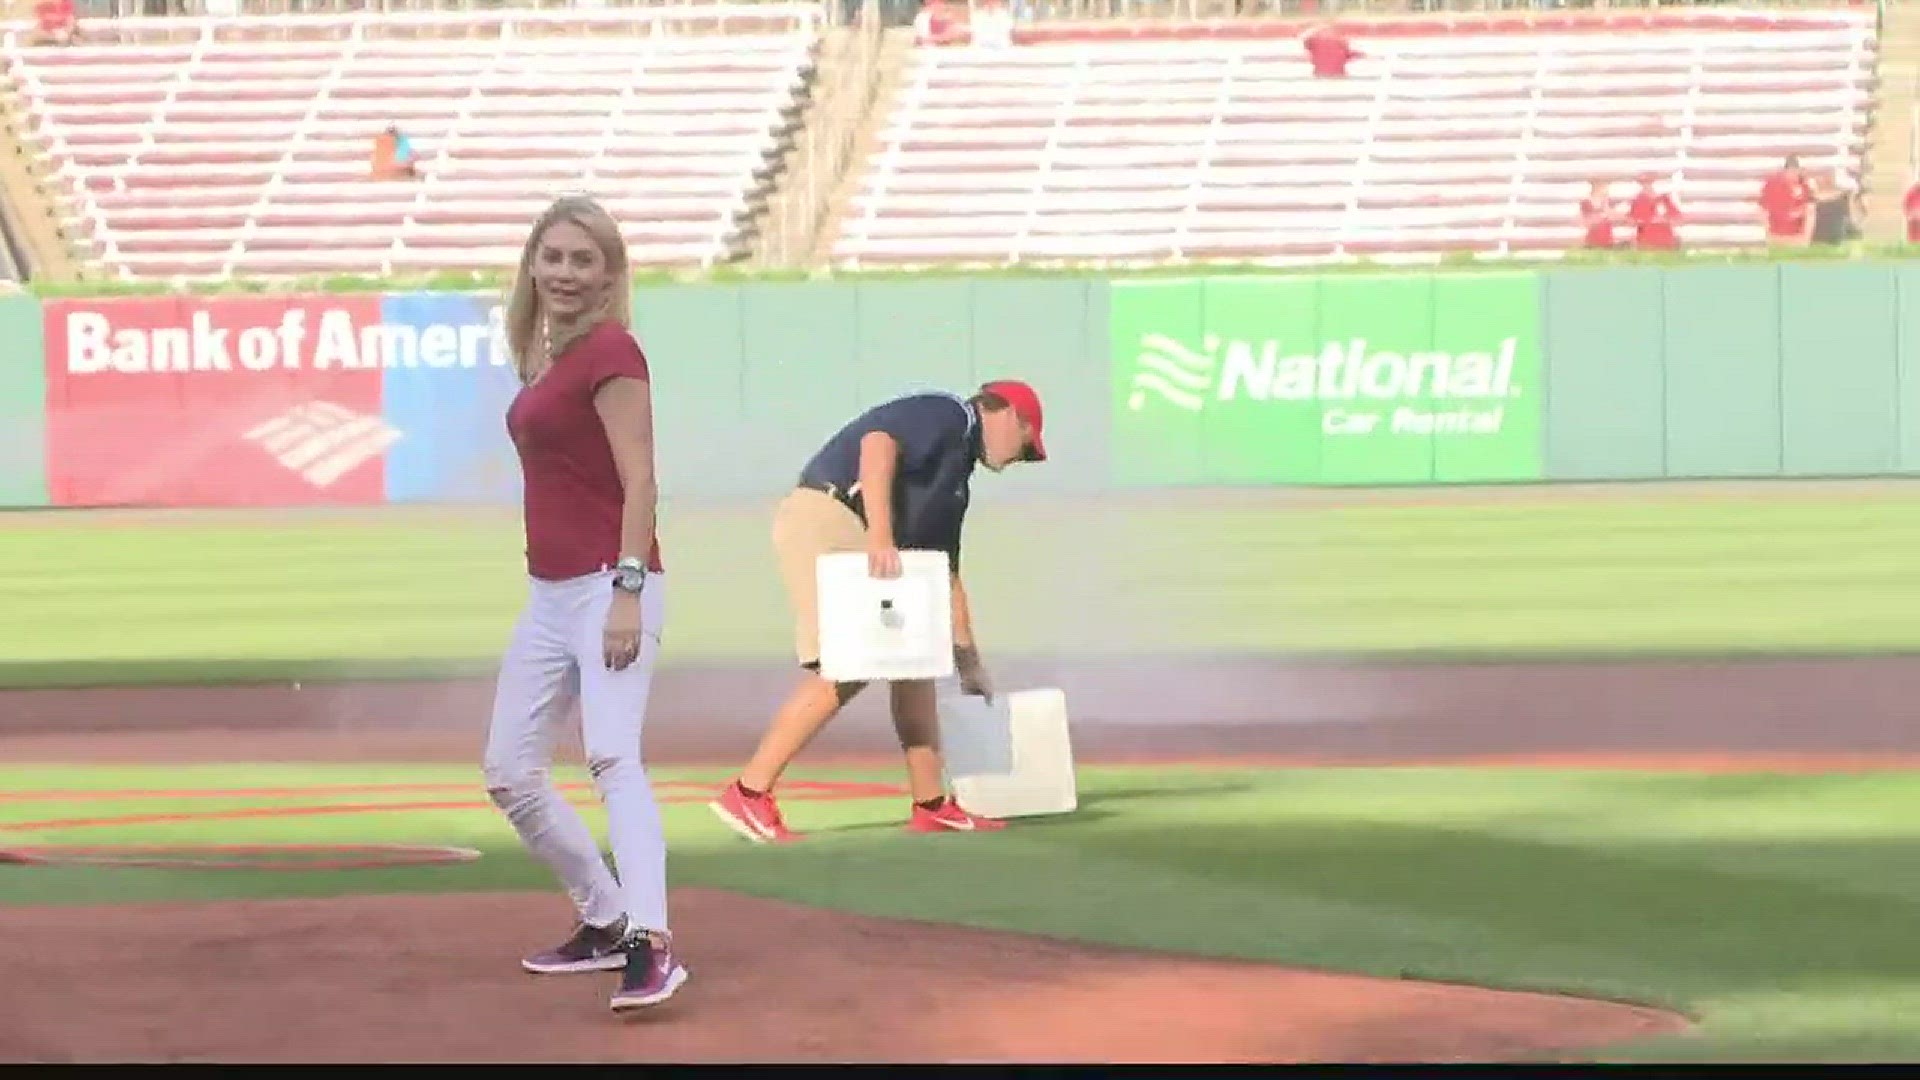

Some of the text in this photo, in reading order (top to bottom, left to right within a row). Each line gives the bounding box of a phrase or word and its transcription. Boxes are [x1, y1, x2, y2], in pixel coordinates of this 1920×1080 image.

[66, 310, 232, 373] Bank
[238, 308, 306, 370] of
[1216, 337, 1518, 401] National
[1321, 405, 1505, 436] Car Rental
